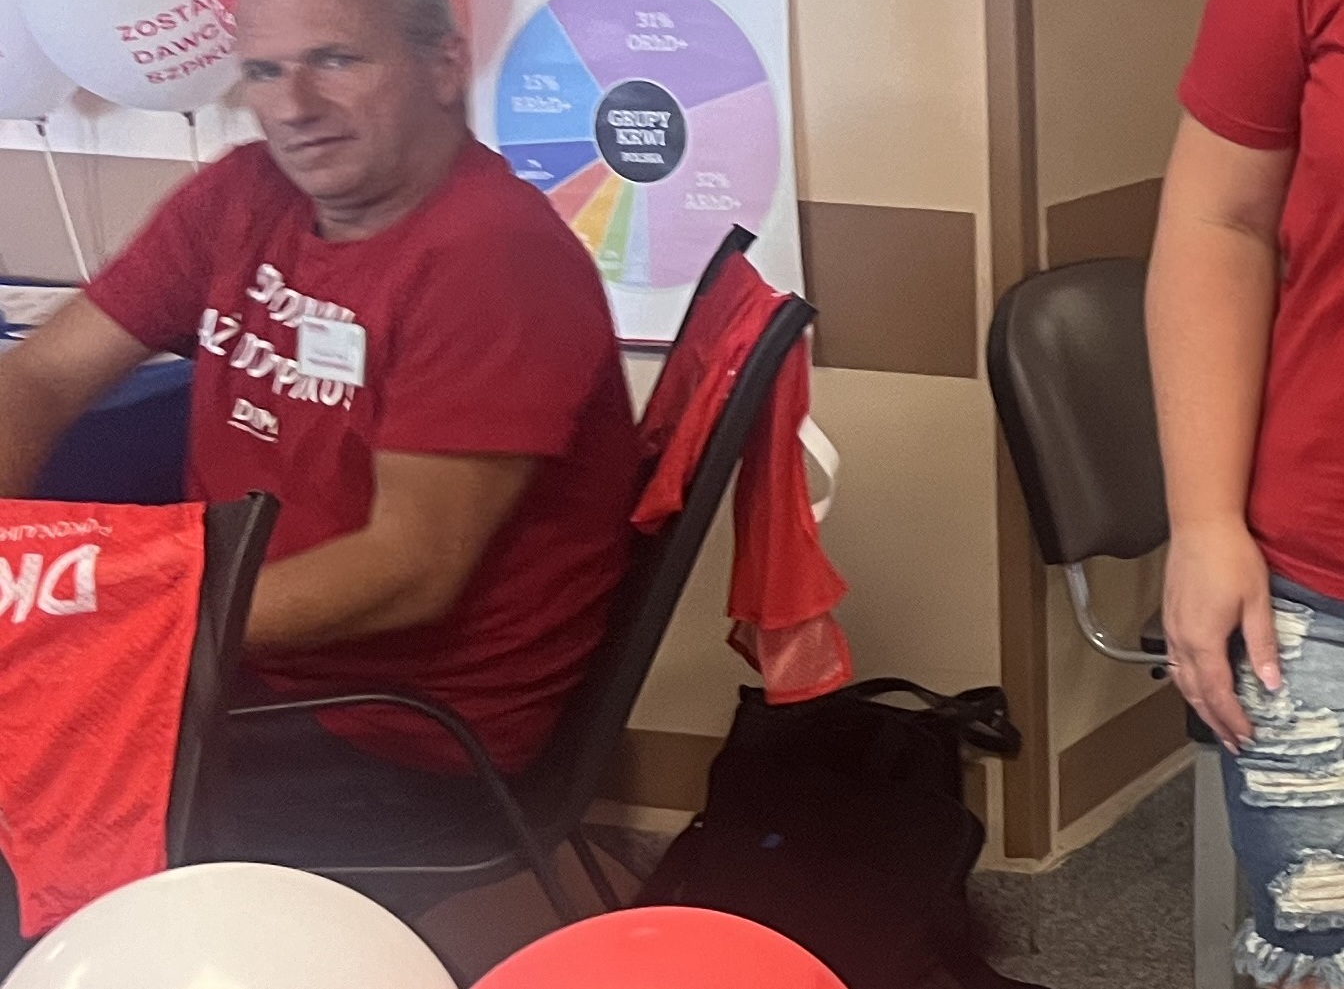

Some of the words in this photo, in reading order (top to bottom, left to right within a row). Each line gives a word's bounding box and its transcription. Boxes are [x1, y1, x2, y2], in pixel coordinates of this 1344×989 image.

[131, 23, 220, 64] DAWC
[607, 110, 671, 128] GRUPY
[615, 129, 667, 146] KRWI
